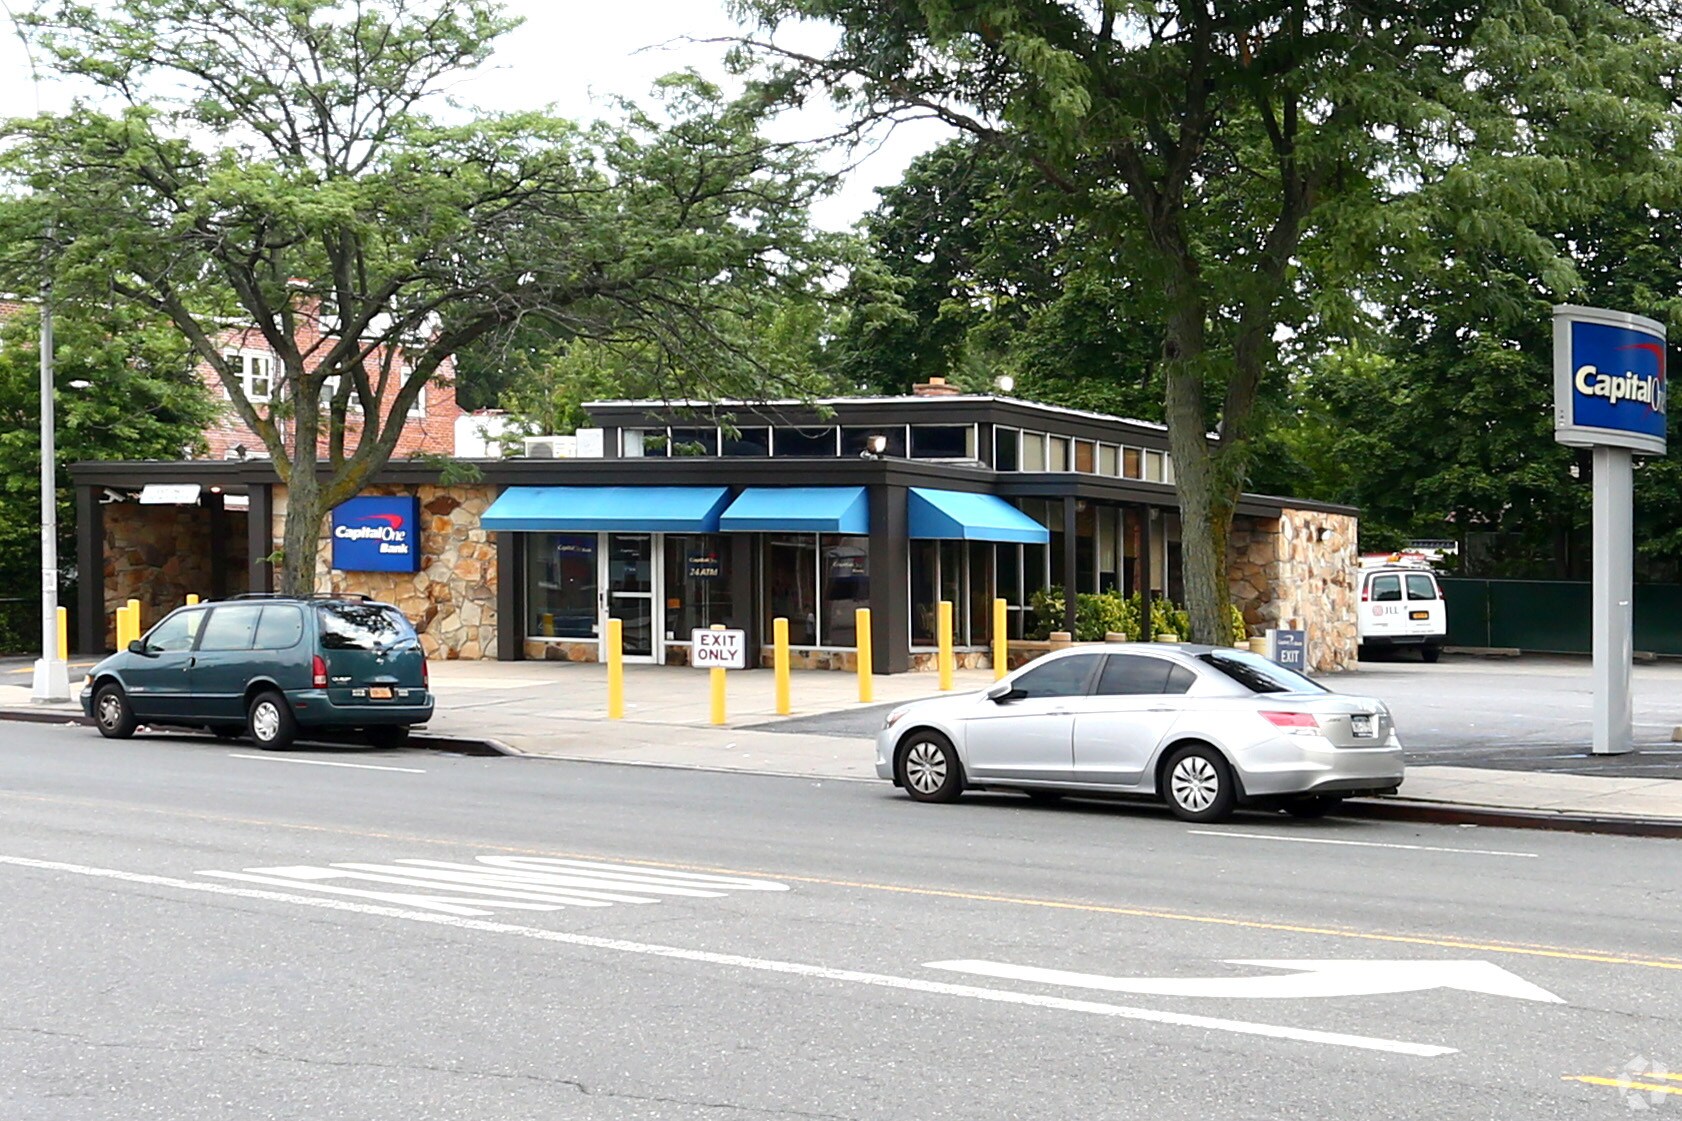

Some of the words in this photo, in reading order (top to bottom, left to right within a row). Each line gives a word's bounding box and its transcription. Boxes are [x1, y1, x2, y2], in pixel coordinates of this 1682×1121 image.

[379, 543, 409, 554] Bank
[1385, 606, 1399, 614] JLL
[700, 634, 736, 647] EXIT
[698, 648, 738, 661] ONLY
[1281, 649, 1300, 663] EXIT
